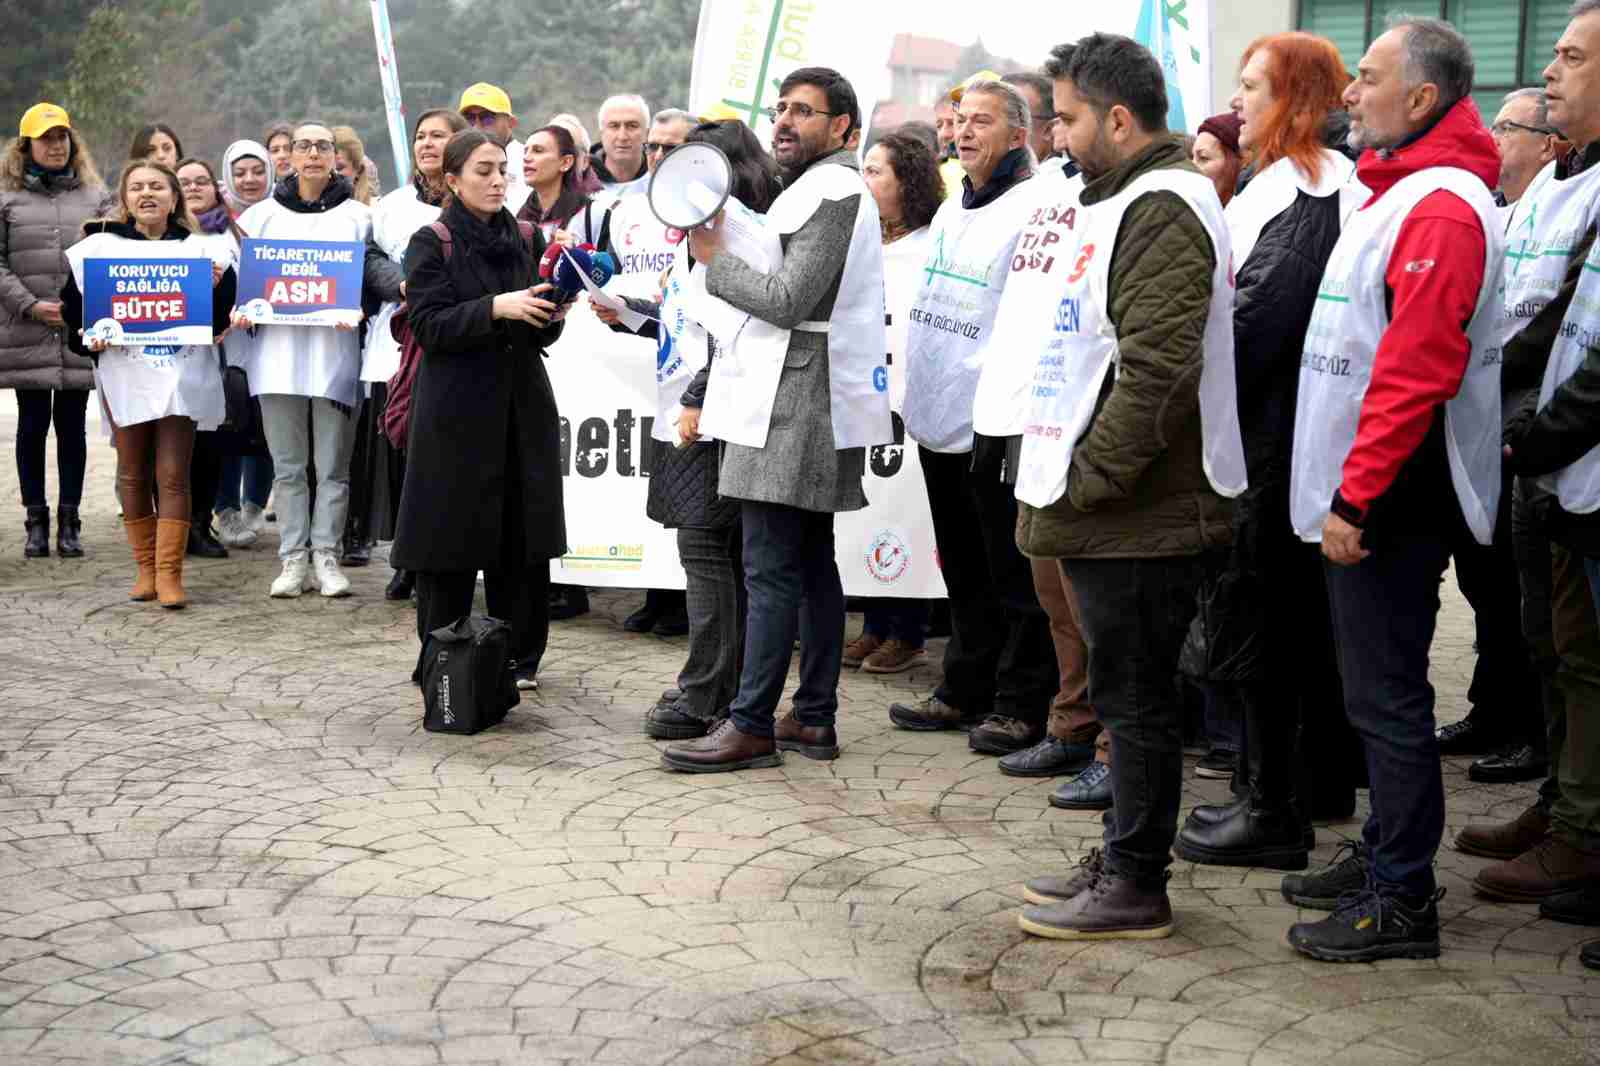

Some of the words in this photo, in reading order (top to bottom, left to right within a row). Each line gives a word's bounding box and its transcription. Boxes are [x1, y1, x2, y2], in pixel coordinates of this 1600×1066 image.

[253, 245, 353, 262] TİCARETHANE
[108, 264, 189, 278] KORUYUCU
[281, 262, 322, 277] DEĞİL
[116, 278, 182, 293] SAĞLIĞA
[269, 281, 329, 304] ASM
[112, 297, 184, 322] BÜTÇE
